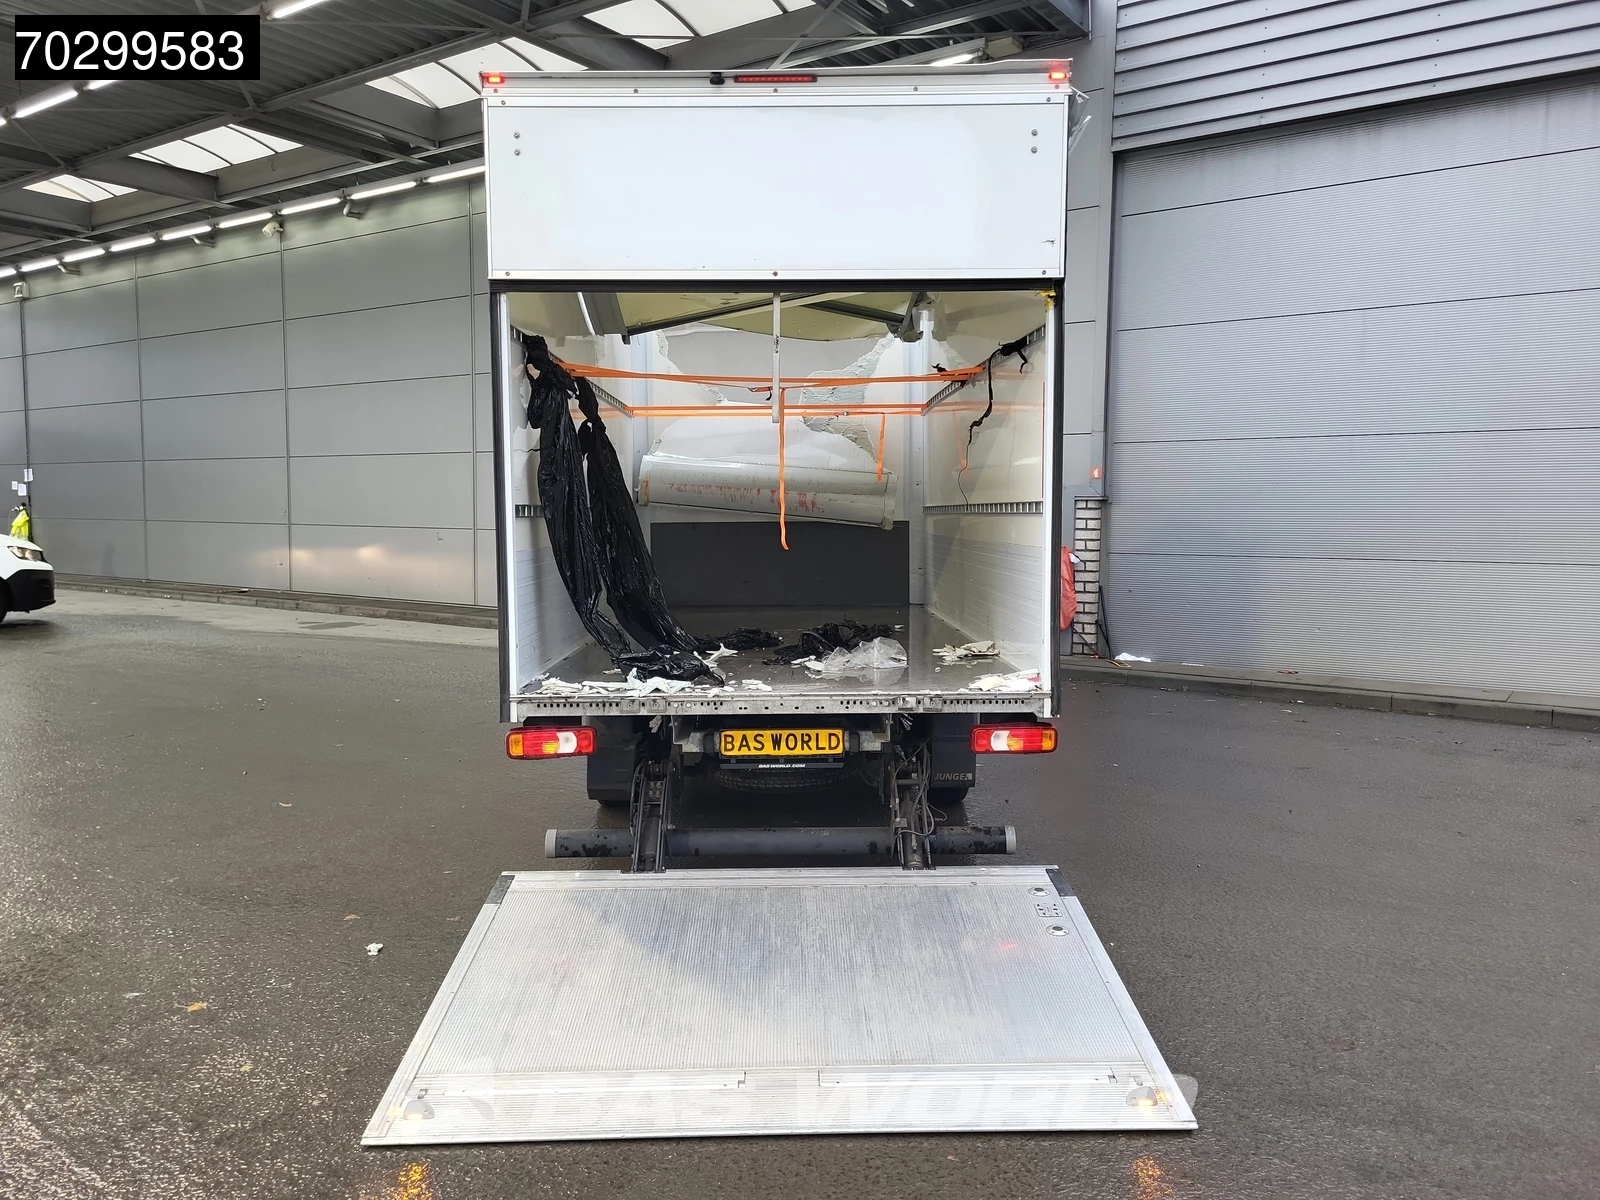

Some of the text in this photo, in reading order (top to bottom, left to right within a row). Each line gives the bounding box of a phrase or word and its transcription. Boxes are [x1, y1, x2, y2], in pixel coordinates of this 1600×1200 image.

[723, 732, 841, 752] BAS WORLD
[934, 772, 966, 781] JUNGE
